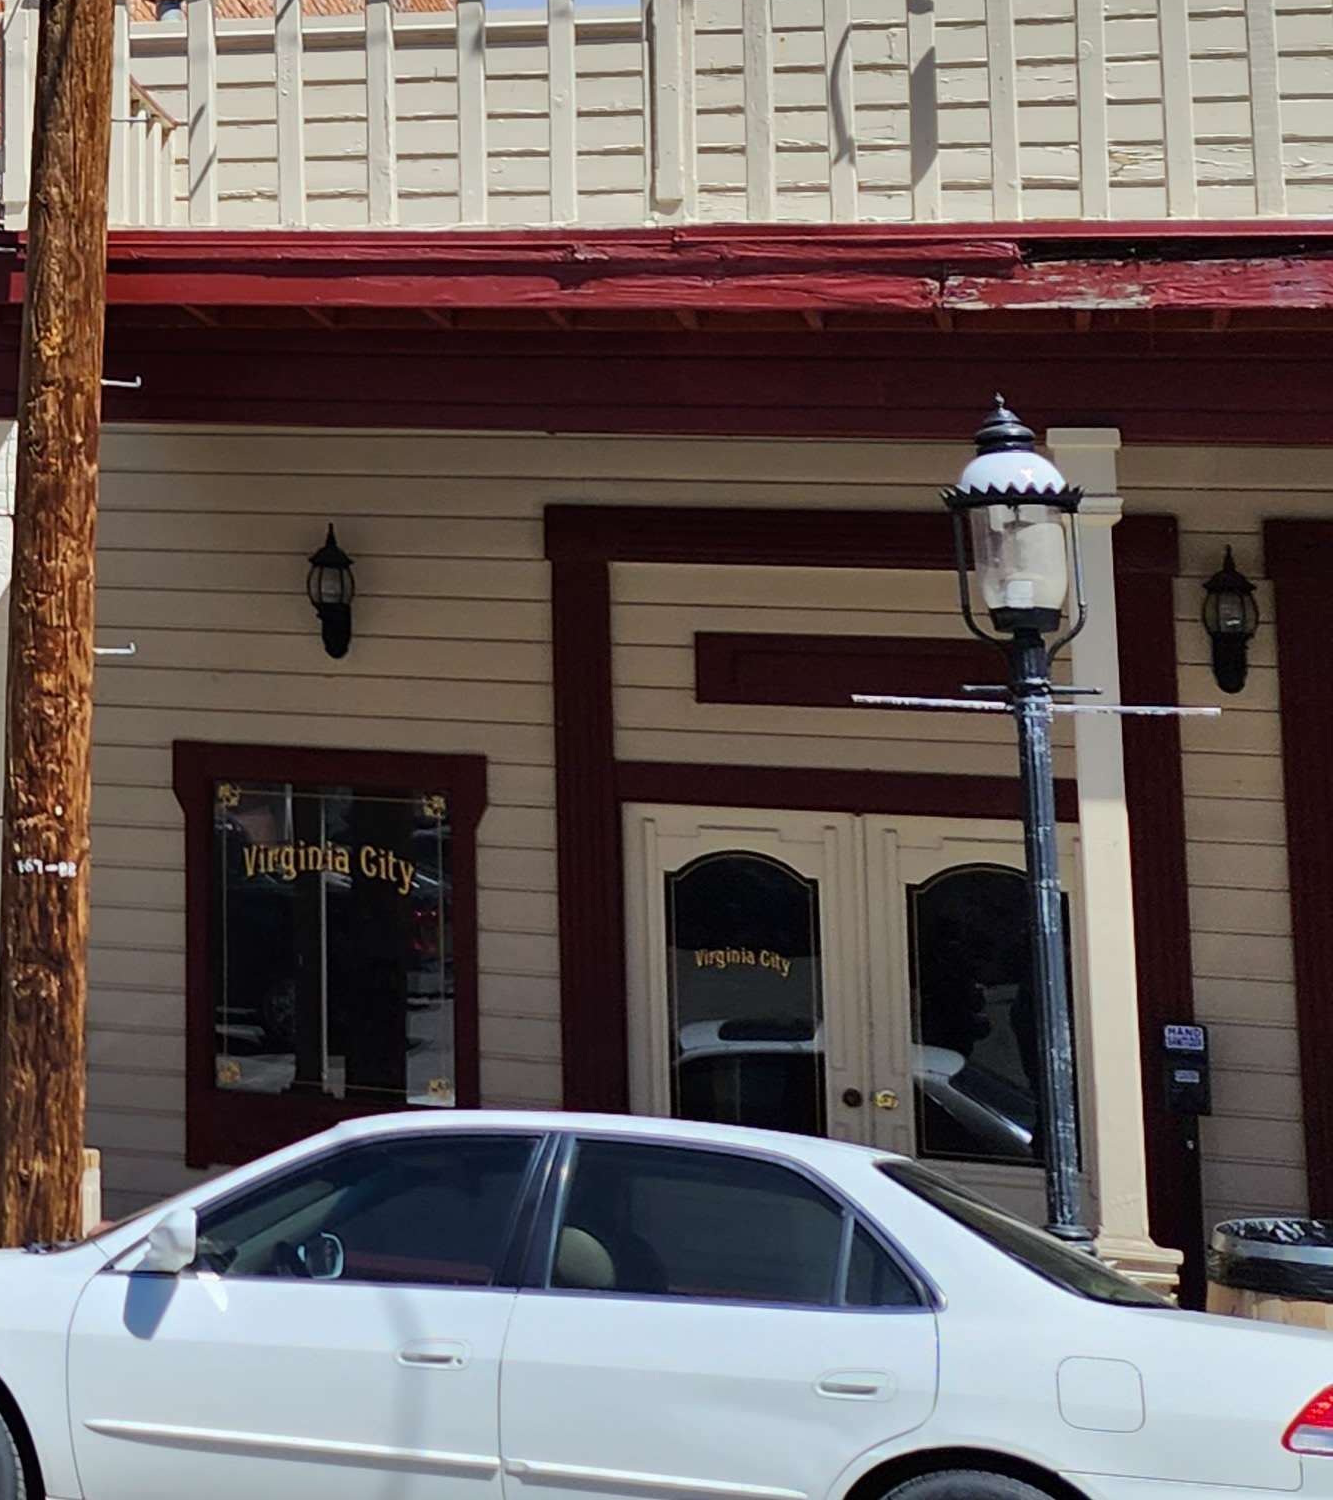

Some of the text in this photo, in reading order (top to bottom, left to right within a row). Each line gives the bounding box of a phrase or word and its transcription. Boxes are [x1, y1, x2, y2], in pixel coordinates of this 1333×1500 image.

[244, 840, 415, 895] Virginia City
[695, 946, 791, 978] Virginia City
